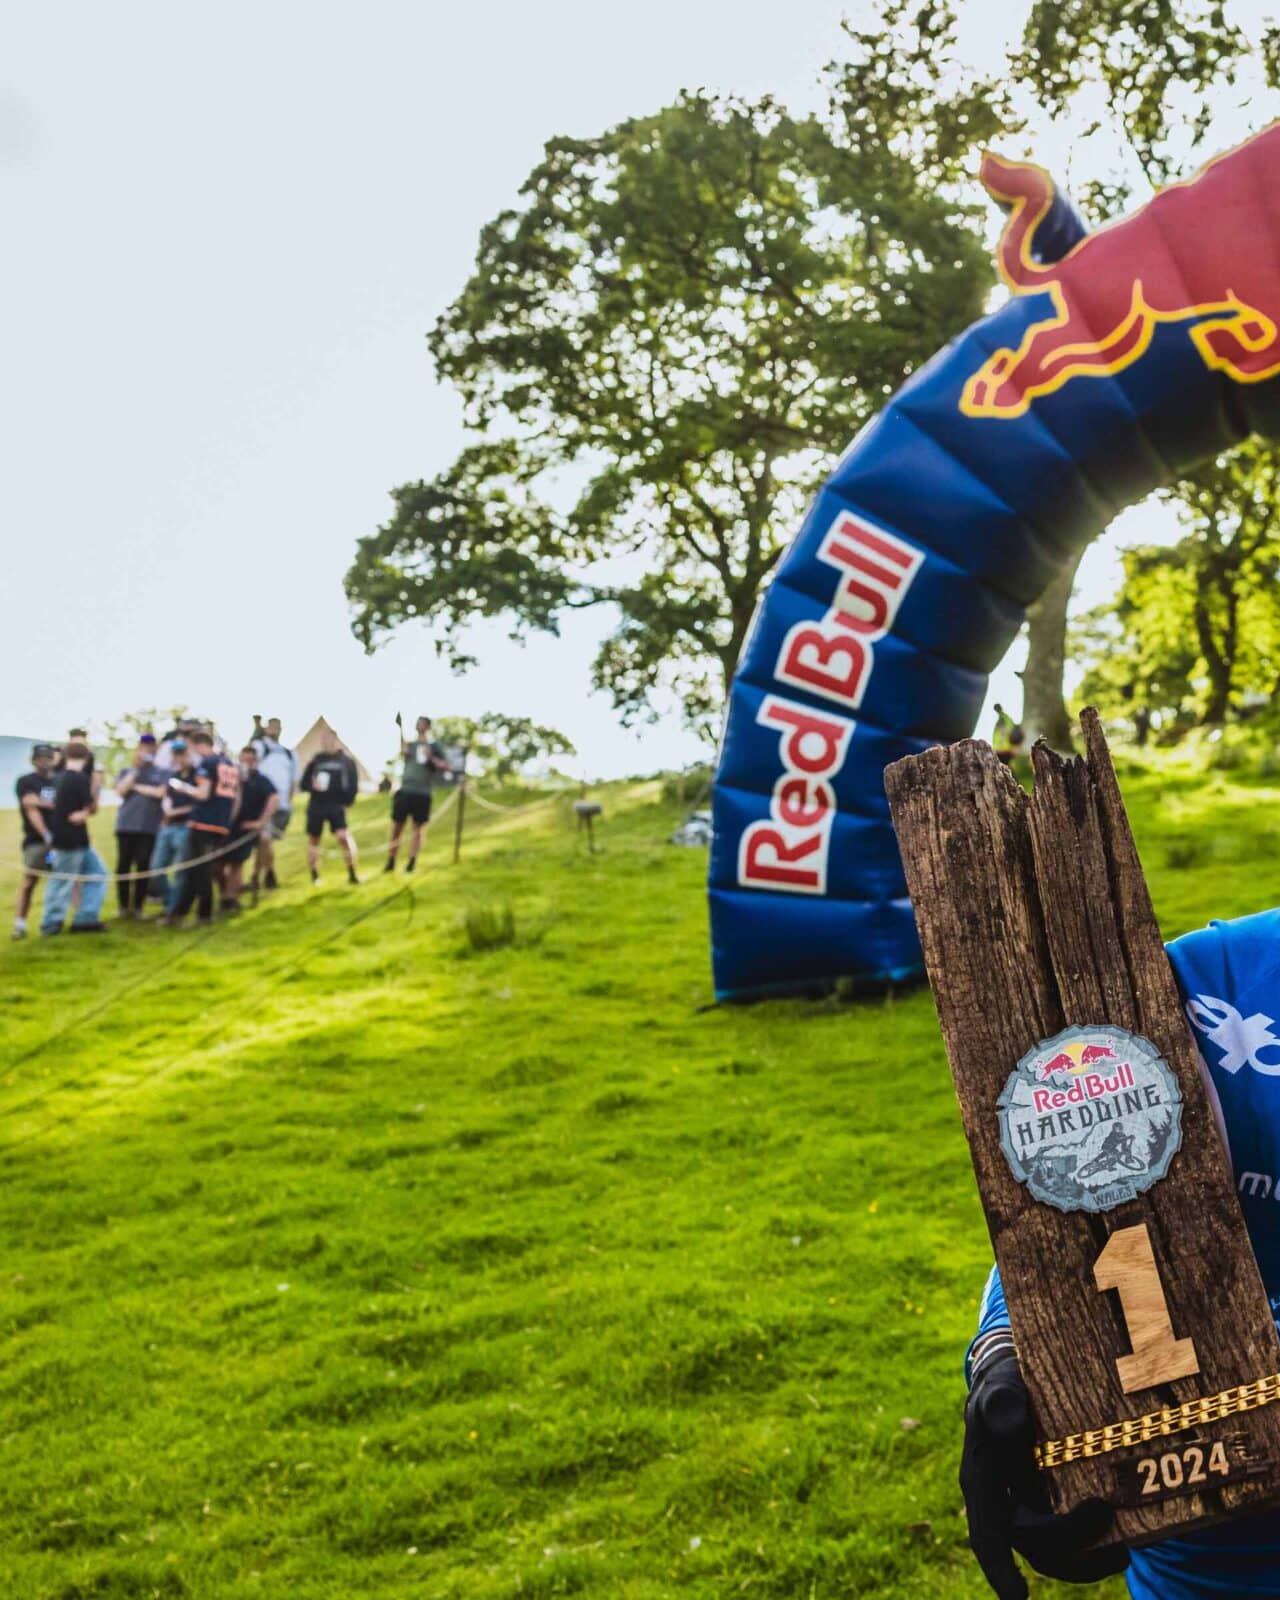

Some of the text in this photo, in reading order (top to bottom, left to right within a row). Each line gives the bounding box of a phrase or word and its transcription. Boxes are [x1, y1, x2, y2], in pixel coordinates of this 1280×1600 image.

[741, 513, 921, 891] Red Bull
[1017, 1084, 1162, 1145] HARDLINE
[1033, 1063, 1135, 1114] Red Bull
[1092, 1187, 1134, 1207] WALES
[1093, 1223, 1200, 1394] 1
[1137, 1441, 1230, 1496] 2024
